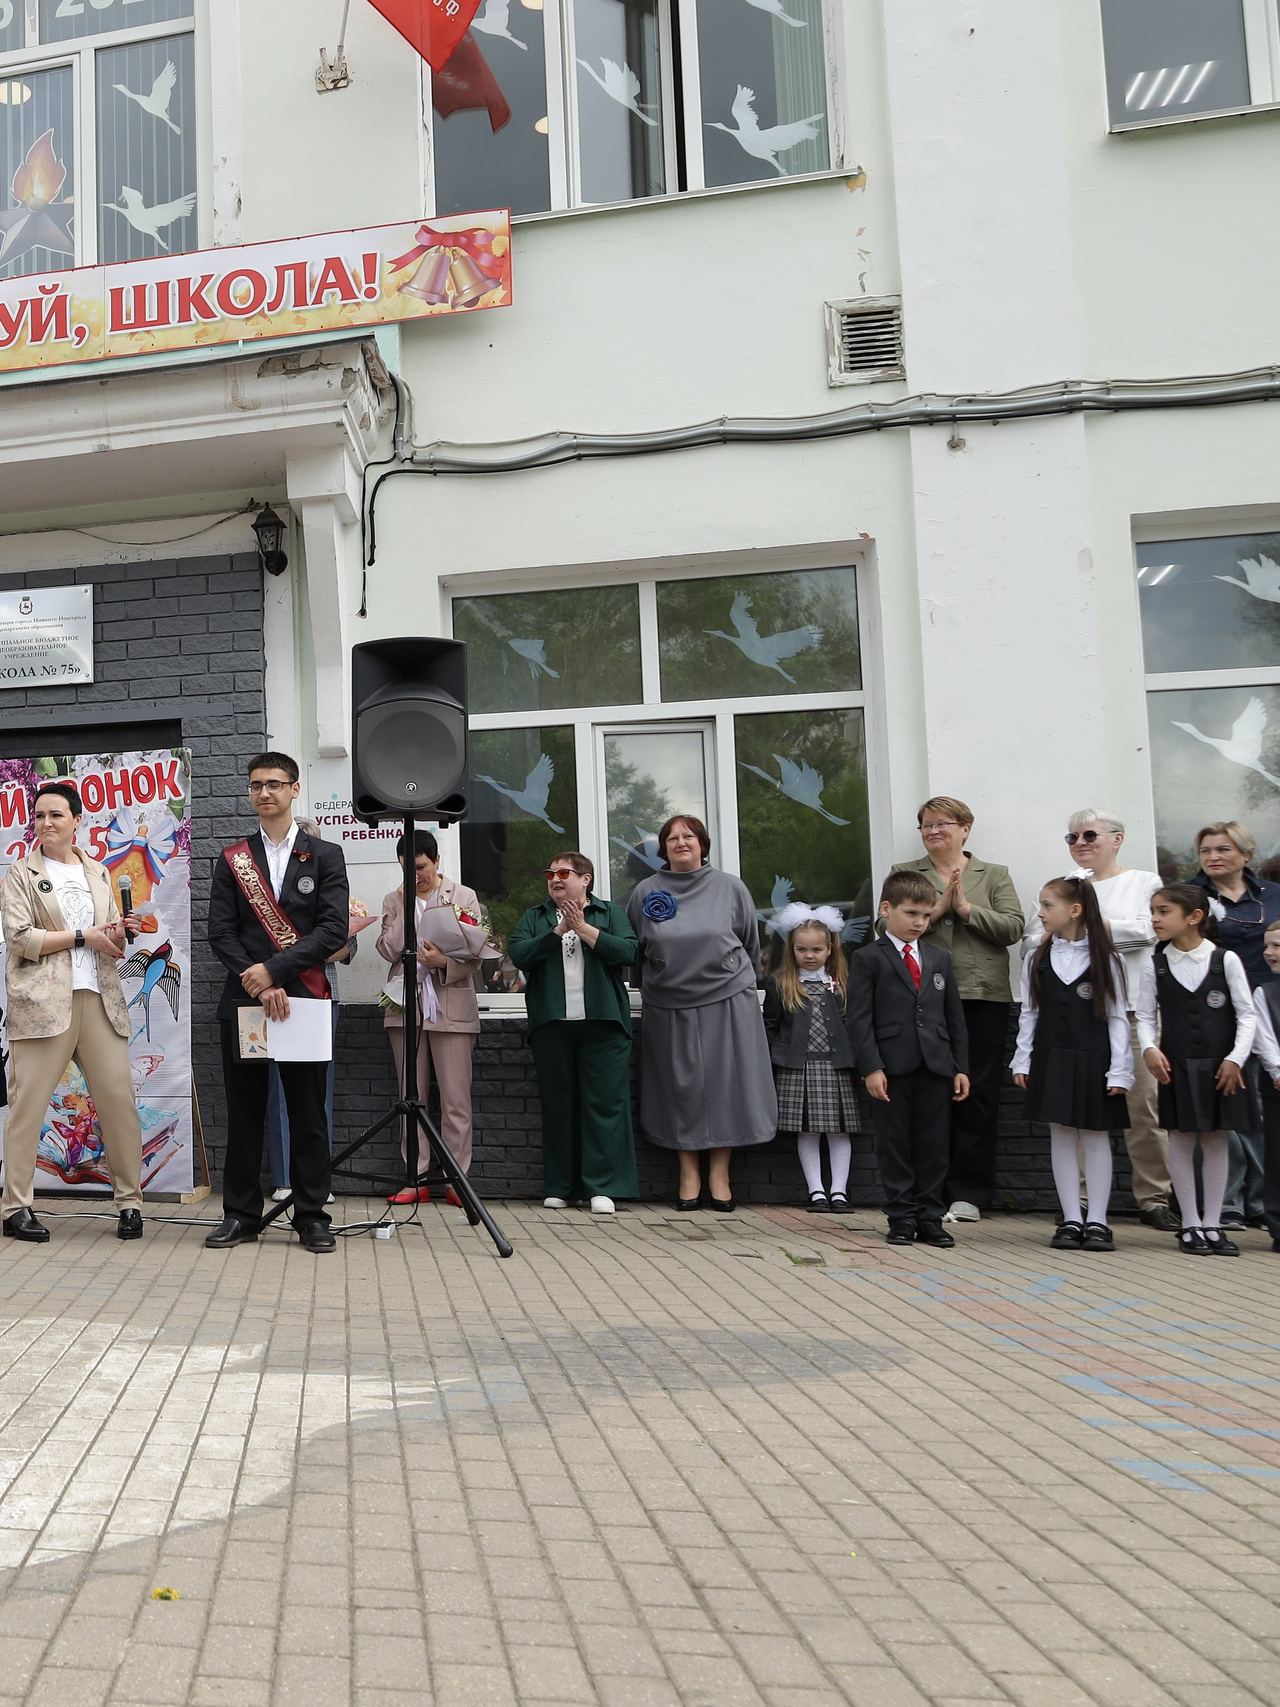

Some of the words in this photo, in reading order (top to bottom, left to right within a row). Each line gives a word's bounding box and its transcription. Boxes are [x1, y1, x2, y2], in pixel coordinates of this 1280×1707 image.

[108, 252, 381, 332] ШКОЛА!
[31, 623, 64, 631] образования
[35, 635, 80, 643] БЮДЖЕТНОЕ
[4, 651, 50, 660] УЧРЕЖДЕНИЕ
[40, 664, 58, 677] №
[61, 663, 81, 676] 75»
[315, 815, 358, 826] УСПЕХ
[342, 829, 405, 841] РЕБЕНКА
